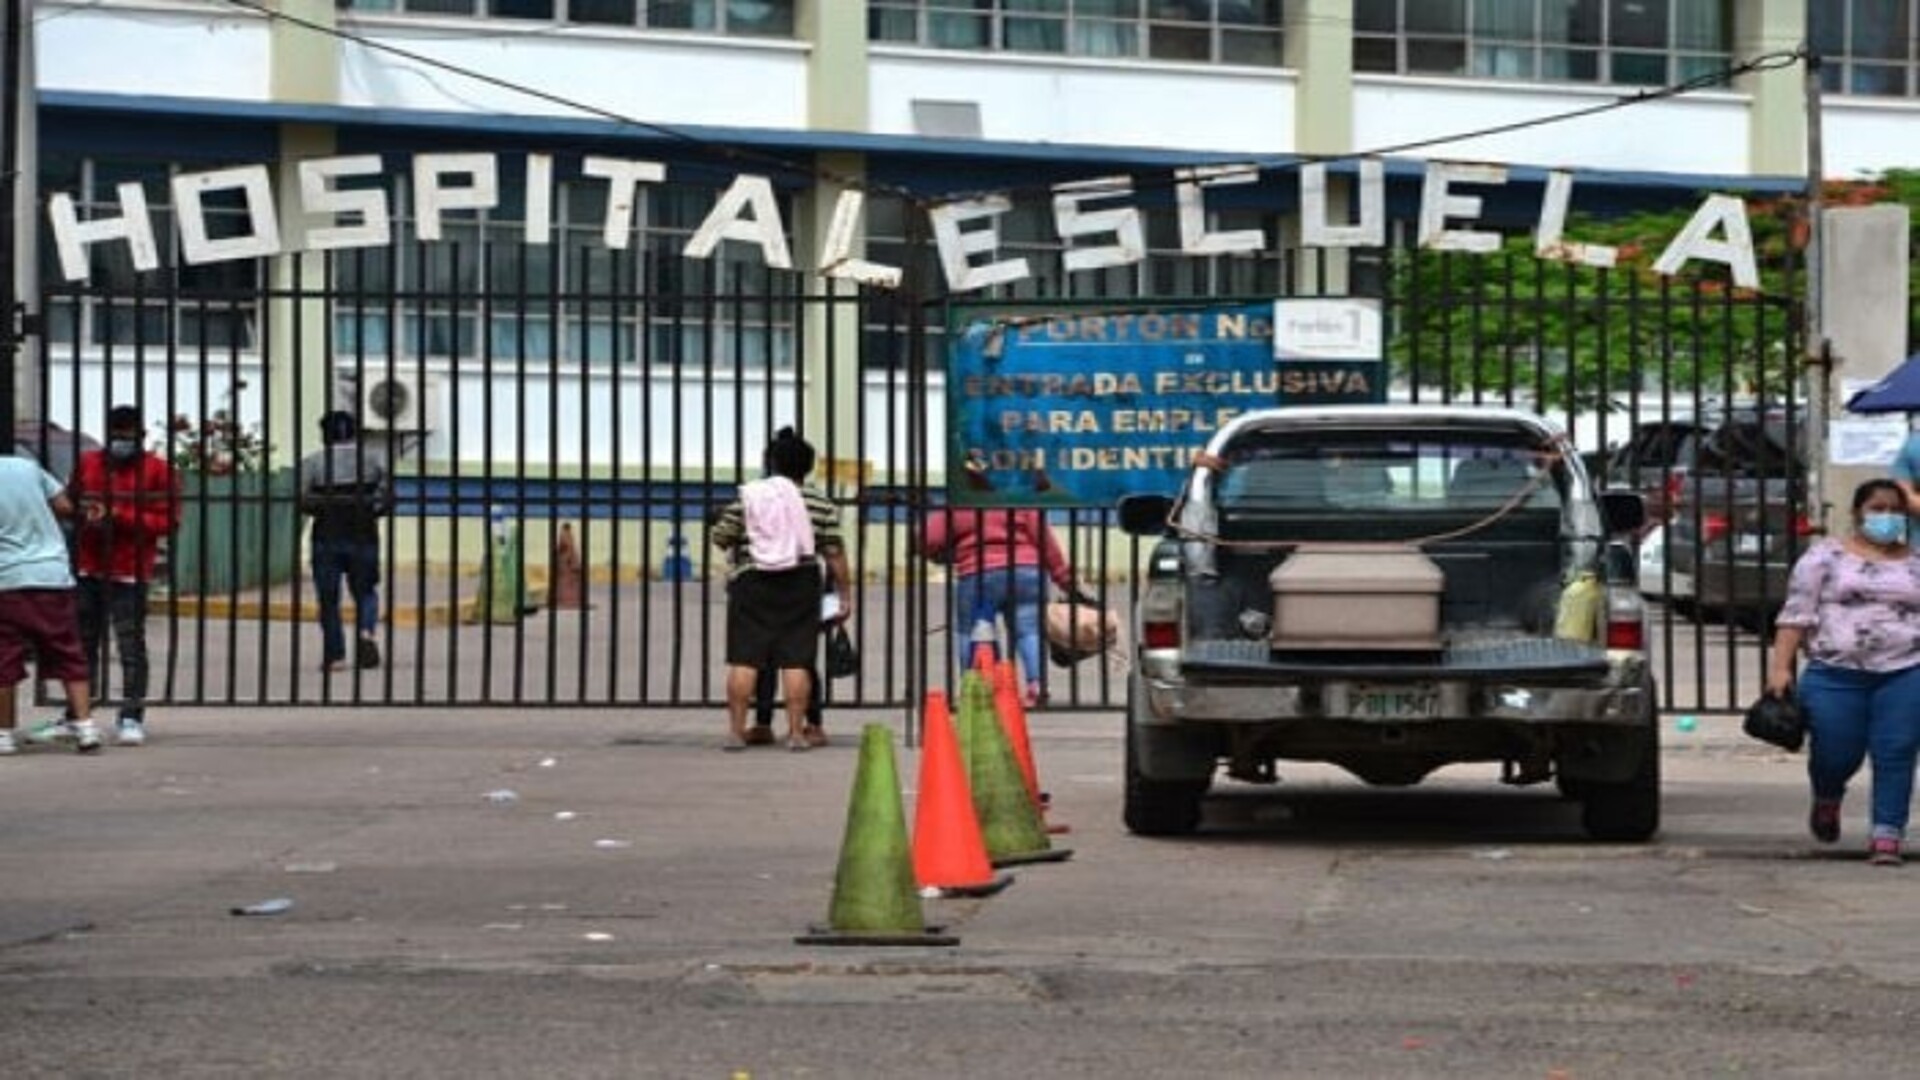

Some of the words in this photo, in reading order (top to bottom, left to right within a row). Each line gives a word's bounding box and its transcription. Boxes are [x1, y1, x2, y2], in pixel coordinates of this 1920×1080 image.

[48, 152, 903, 288] HOSPITAL
[929, 157, 1762, 291] ESCUELA
[965, 371, 1143, 397] ENTRADA
[1155, 369, 1370, 396] EXCLUSIVA
[1002, 409, 1101, 433] PARA
[1112, 409, 1240, 433] EMPLE
